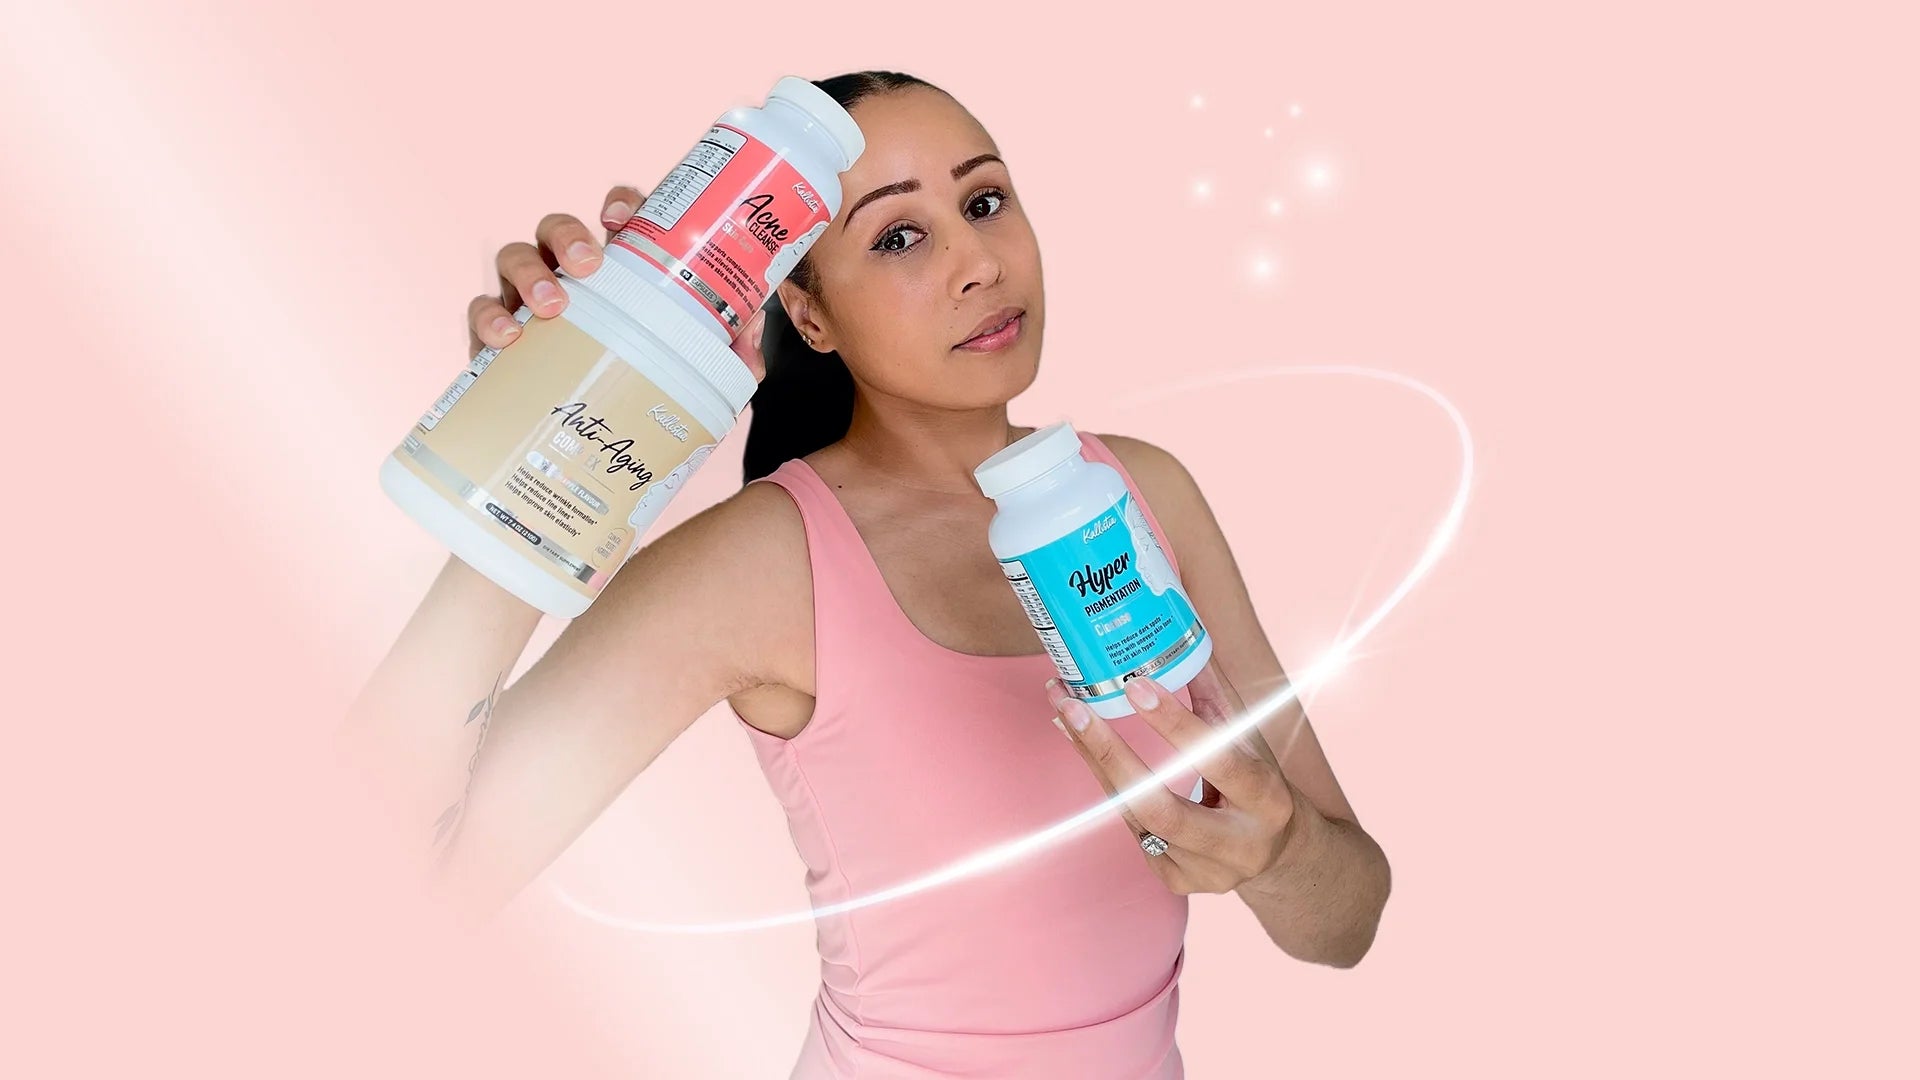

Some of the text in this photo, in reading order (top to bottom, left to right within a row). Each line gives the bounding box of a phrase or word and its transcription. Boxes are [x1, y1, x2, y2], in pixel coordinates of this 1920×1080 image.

[792, 182, 819, 214] Kallista
[739, 194, 788, 240] Acne
[749, 222, 779, 255] CLEANSE
[690, 277, 714, 299] CAPSULES
[646, 403, 690, 442] Kallista
[551, 402, 655, 491] Anti-Aging
[504, 480, 522, 496] Helps
[543, 508, 556, 520] skin
[510, 473, 528, 489] Helps
[527, 485, 547, 502] reduce
[545, 498, 558, 510] fine
[516, 465, 534, 481] Helps
[533, 477, 553, 495] reduce
[552, 491, 573, 509] wrinkle
[1082, 515, 1117, 544] Kallista
[1069, 551, 1130, 597] Hyper
[1085, 578, 1141, 617] PIGMENTATION
[1105, 640, 1120, 652] Helps
[1120, 631, 1137, 643] reduce
[1137, 624, 1149, 634] dark
[1109, 647, 1124, 659] Helps
[1124, 641, 1136, 651] with
[1135, 632, 1154, 645] uneven
[1152, 624, 1164, 633] skin
[1113, 657, 1122, 665] For
[1122, 653, 1130, 661] all
[1130, 648, 1141, 657] skin
